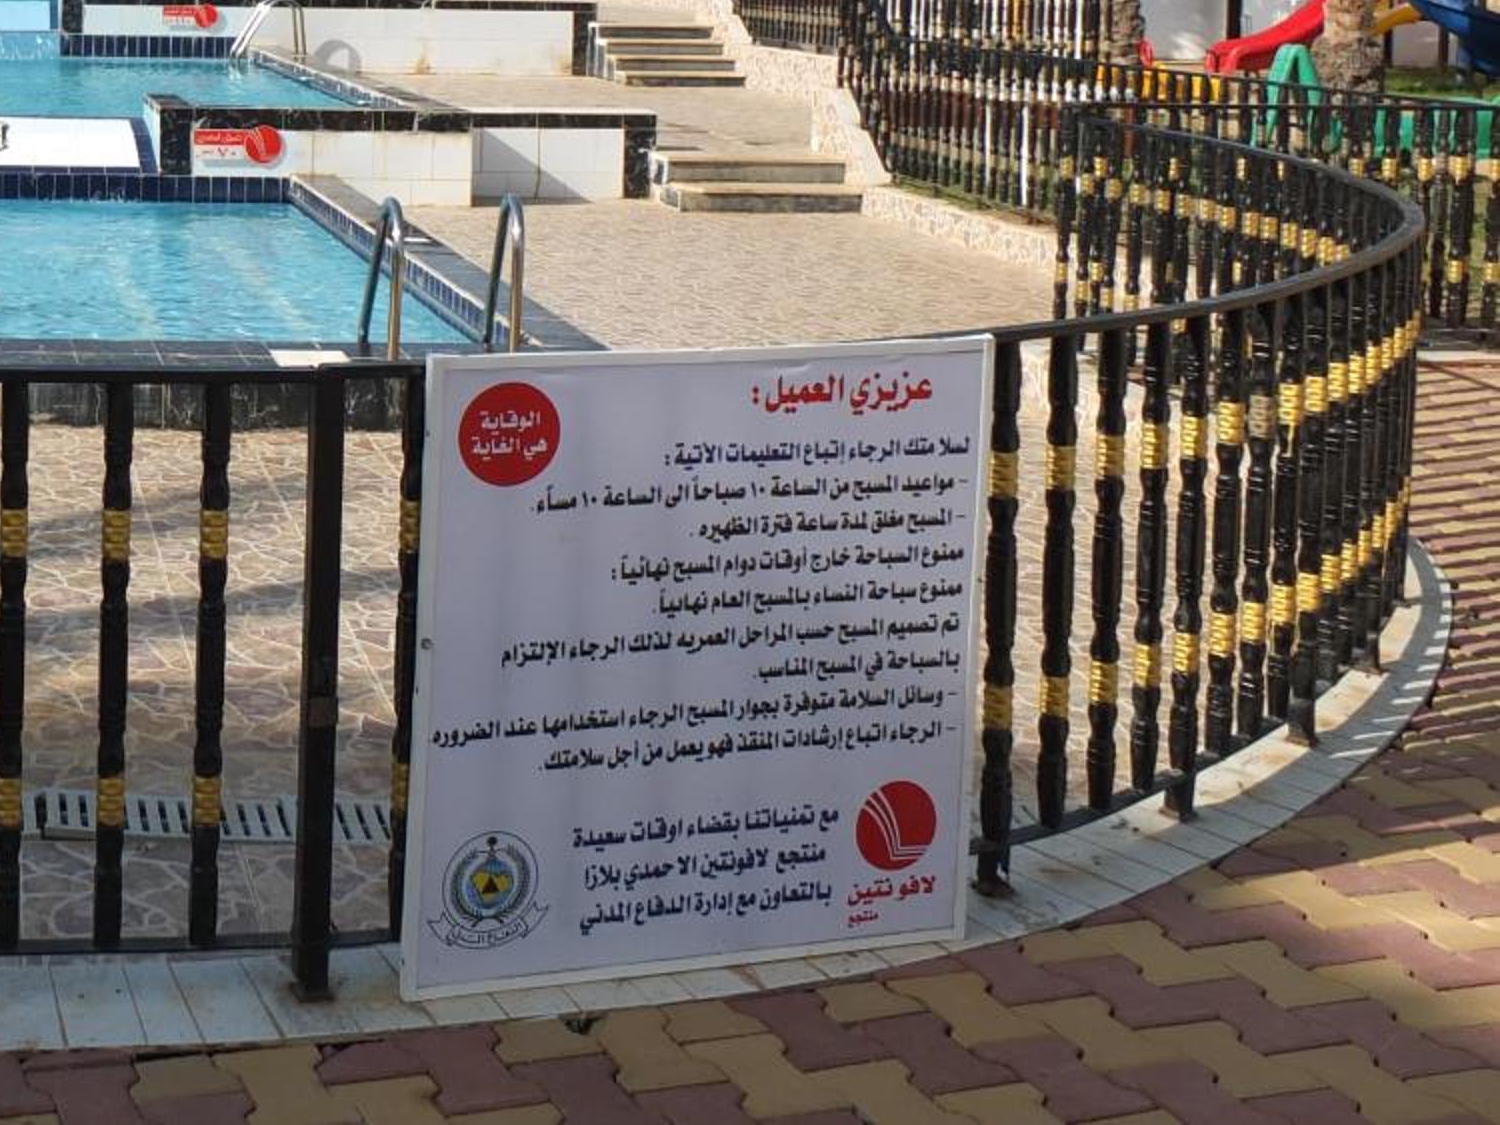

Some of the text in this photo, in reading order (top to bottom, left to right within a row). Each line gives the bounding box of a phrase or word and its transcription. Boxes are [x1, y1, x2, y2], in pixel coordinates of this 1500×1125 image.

[850, 371, 933, 415] عزيزي
[480, 410, 541, 434] الوقاية
[471, 436, 548, 461] هي الغاية
[725, 441, 800, 467] التعليمات
[849, 439, 901, 463] الرجاء
[603, 484, 661, 507] الساعة
[770, 476, 827, 497] الساعة
[829, 478, 849, 499] من
[852, 475, 899, 501] المسبح
[901, 474, 955, 497] مواعيد
[760, 513, 793, 537] فترة
[797, 512, 838, 531] ساعة
[840, 511, 868, 530] لمدة
[870, 511, 904, 533] مغلق
[907, 507, 952, 533] المسبح
[724, 555, 756, 577] دوام
[759, 546, 807, 573] أوقات
[810, 546, 850, 573] خارج
[855, 545, 918, 569] السباحة
[921, 543, 964, 568] ممنوع
[673, 554, 720, 583] المسبح
[711, 589, 750, 614] العام
[753, 585, 810, 613] بالمسبح
[813, 582, 864, 607] النساء
[867, 580, 917, 603] سباحة
[919, 578, 962, 603] ممنوع
[738, 622, 792, 648] المراحل
[795, 624, 834, 645] حسب
[837, 618, 884, 644] المسبح
[887, 613, 937, 640] تصميم
[941, 612, 960, 638] تم
[569, 635, 624, 661] الرجاء
[628, 630, 672, 652] لذلك
[815, 654, 862, 681] المسبح
[864, 651, 883, 681] في
[887, 648, 961, 673] بالسباحة
[783, 691, 836, 716] متوفرة
[839, 687, 895, 709] السلامة
[898, 683, 943, 709] وسائل
[628, 703, 683, 729] الرجاء
[687, 699, 733, 726] المسبح
[736, 697, 779, 721] بجوار
[503, 716, 537, 737] عند
[543, 708, 625, 737] استخدامها
[890, 720, 941, 744] الرجاء
[707, 732, 733, 759] فهو
[737, 728, 779, 752] المنقذ
[782, 723, 843, 751] إرشادات
[845, 722, 887, 749] اتباع
[607, 740, 639, 769] أجل
[641, 744, 663, 766] من
[666, 739, 703, 763] يعمل
[572, 804, 839, 852] مع تمنياتنا بقضاء اوقات سعيدة
[699, 847, 769, 879] لافونتين
[775, 843, 827, 874] منتجع
[584, 865, 621, 891] بلازا
[579, 881, 832, 936] بالتعاون مع إدارة الدفاع المدني
